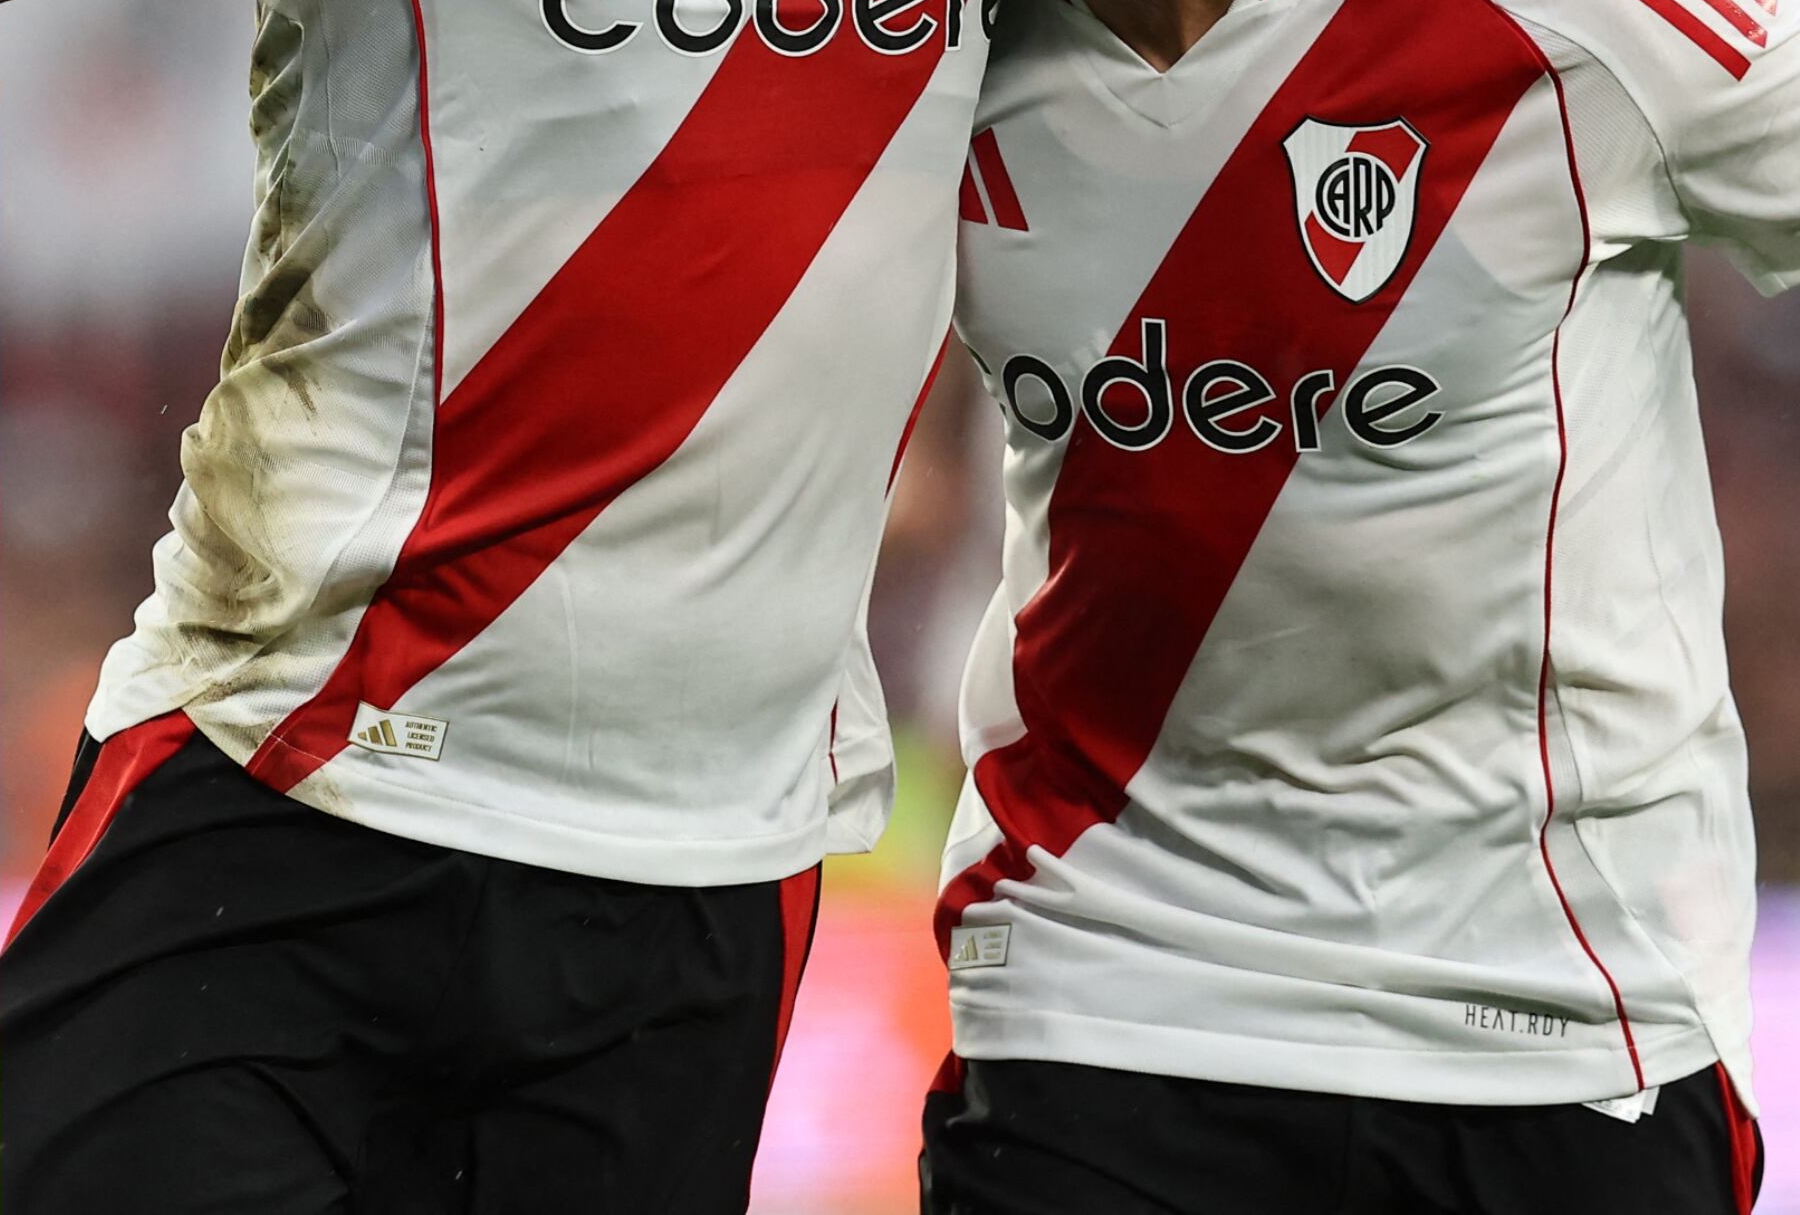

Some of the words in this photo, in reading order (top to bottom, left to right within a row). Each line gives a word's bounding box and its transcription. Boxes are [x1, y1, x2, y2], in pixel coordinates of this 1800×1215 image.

[1315, 157, 1396, 238] CARP
[967, 318, 1446, 454] odere
[1464, 1003, 1570, 1037] HEAT.RDY
